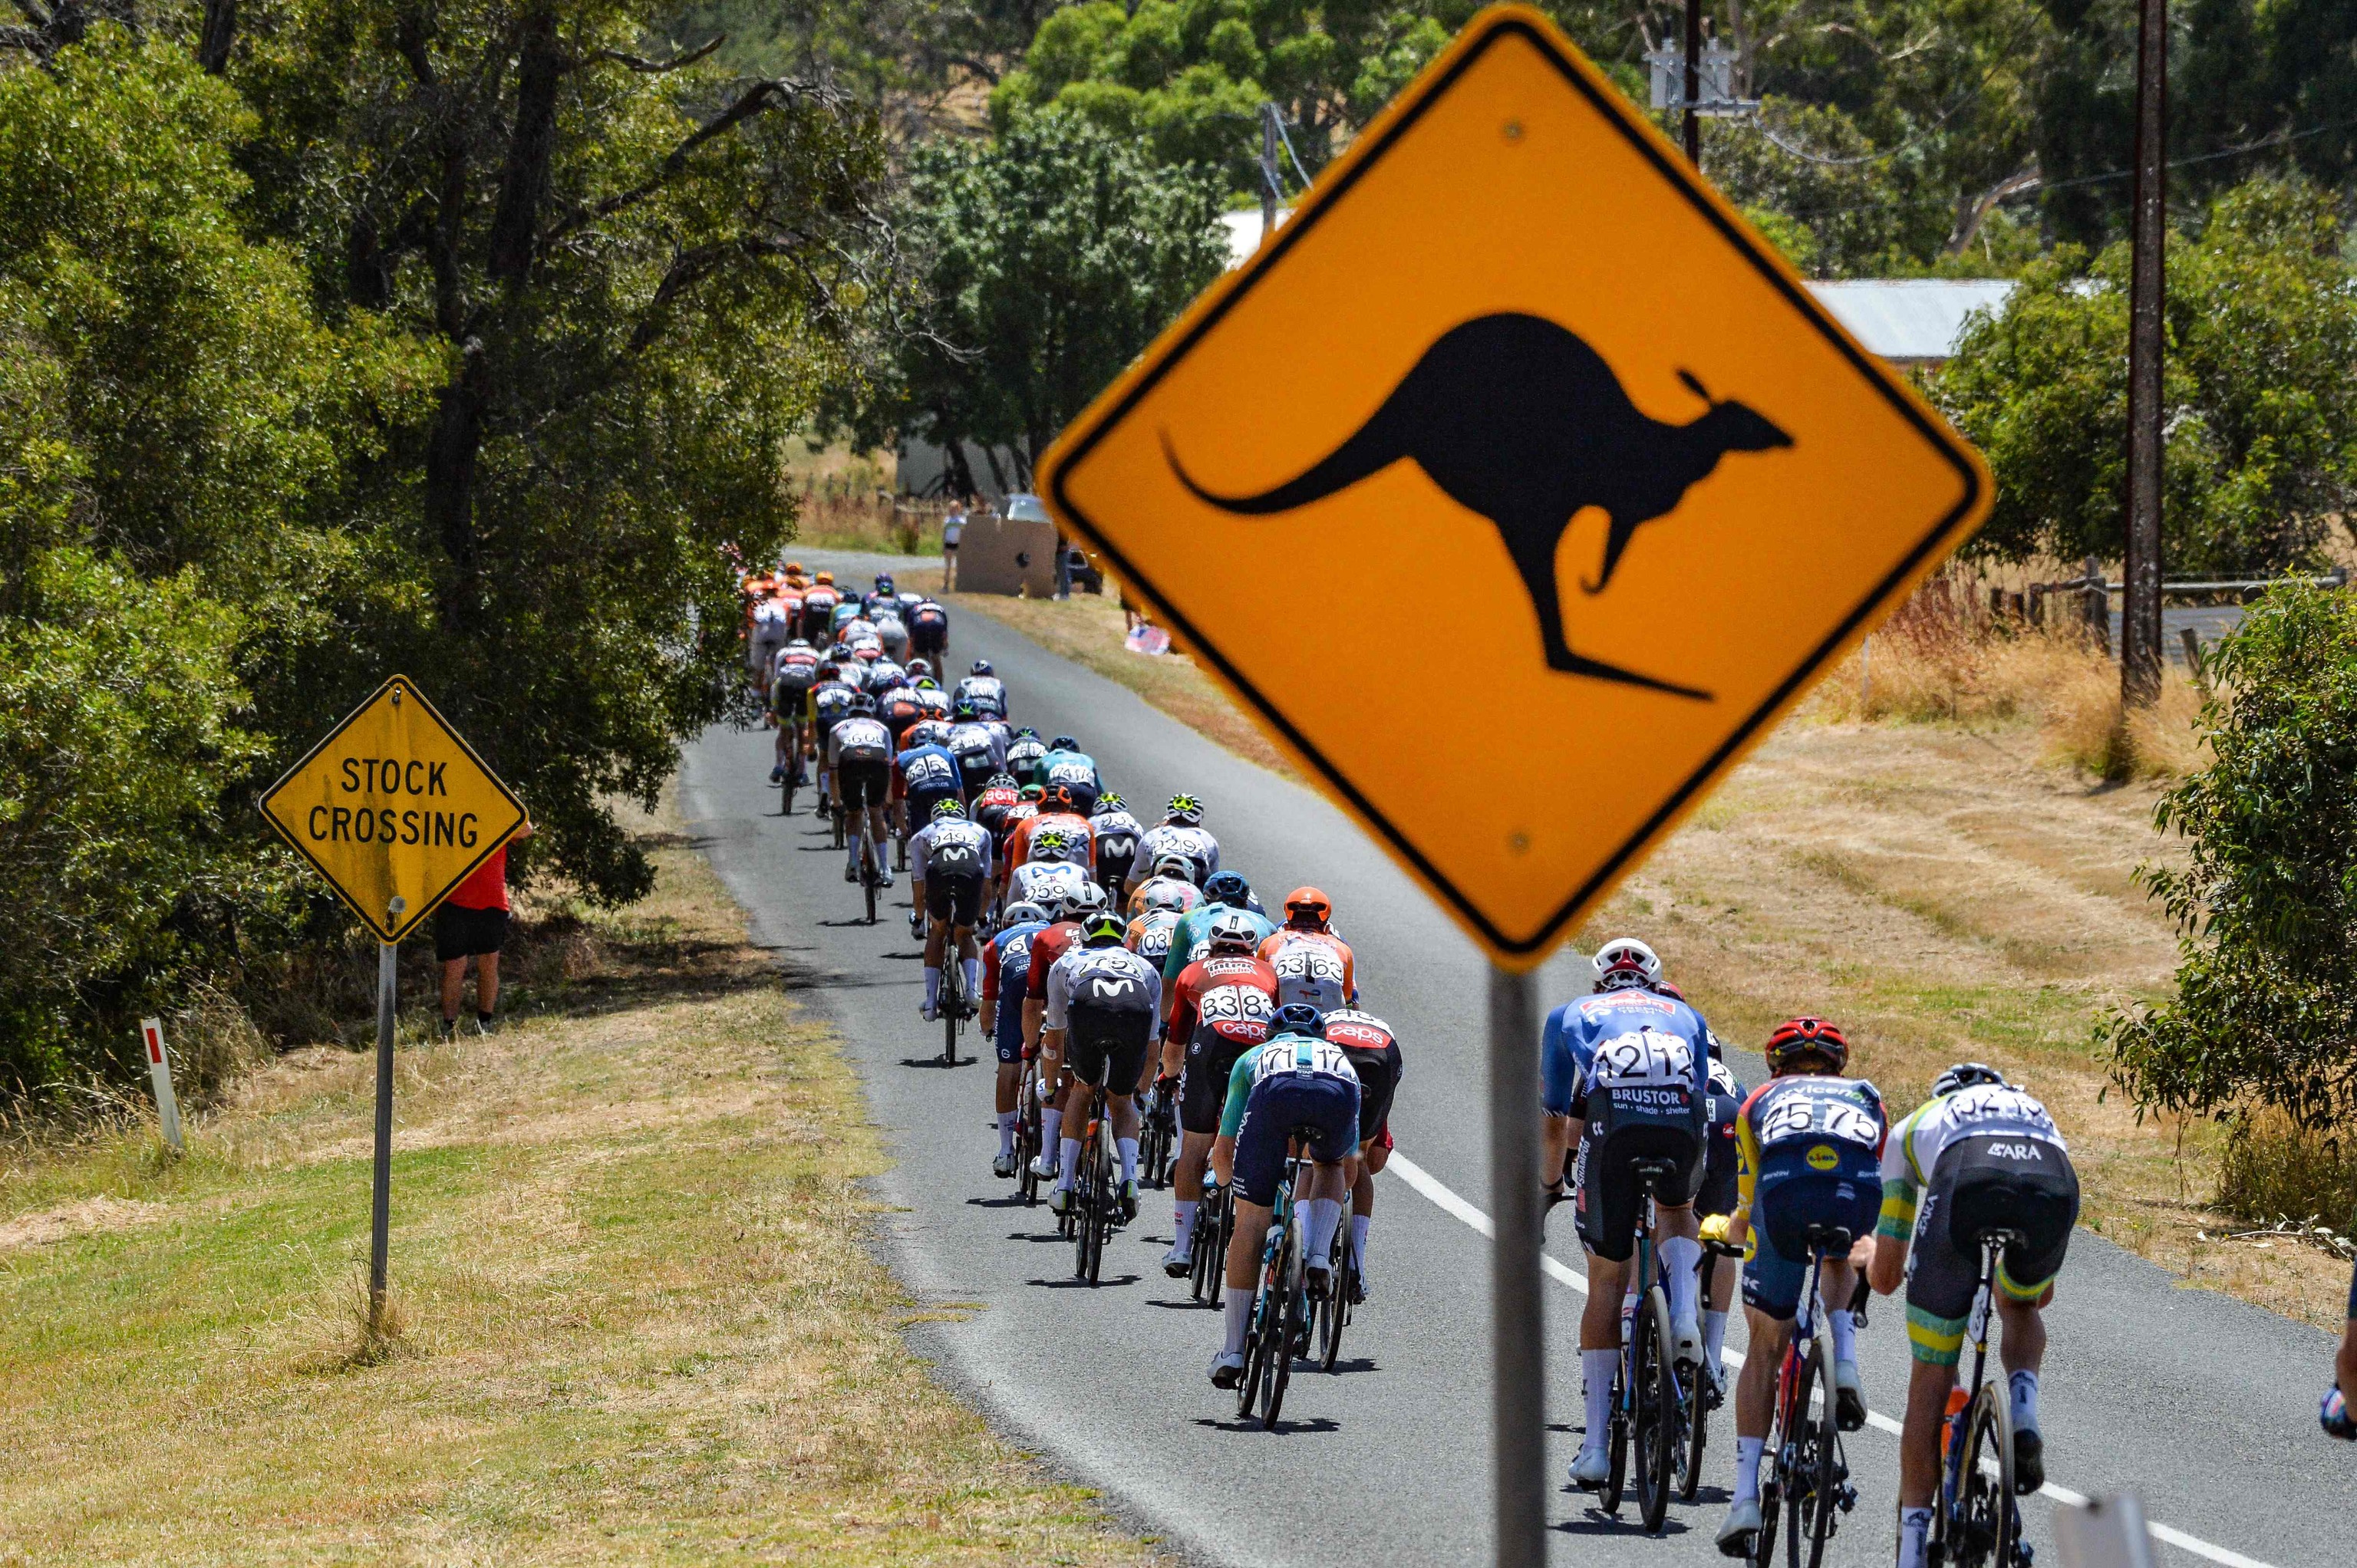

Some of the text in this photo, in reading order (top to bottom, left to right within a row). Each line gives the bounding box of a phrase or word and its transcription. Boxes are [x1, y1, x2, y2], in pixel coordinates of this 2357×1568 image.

[341, 757, 447, 796] STOCK
[308, 805, 477, 848] CROSSING
[1203, 996, 1238, 1020] 83
[1328, 1025, 1383, 1045] caps
[1612, 1089, 1680, 1105] BRUSTOR
[1636, 1105, 1658, 1115] shade
[1666, 1106, 1690, 1115] shelter
[1826, 1103, 1877, 1141] 75
[1577, 1140, 1591, 1184] SHAMPOO
